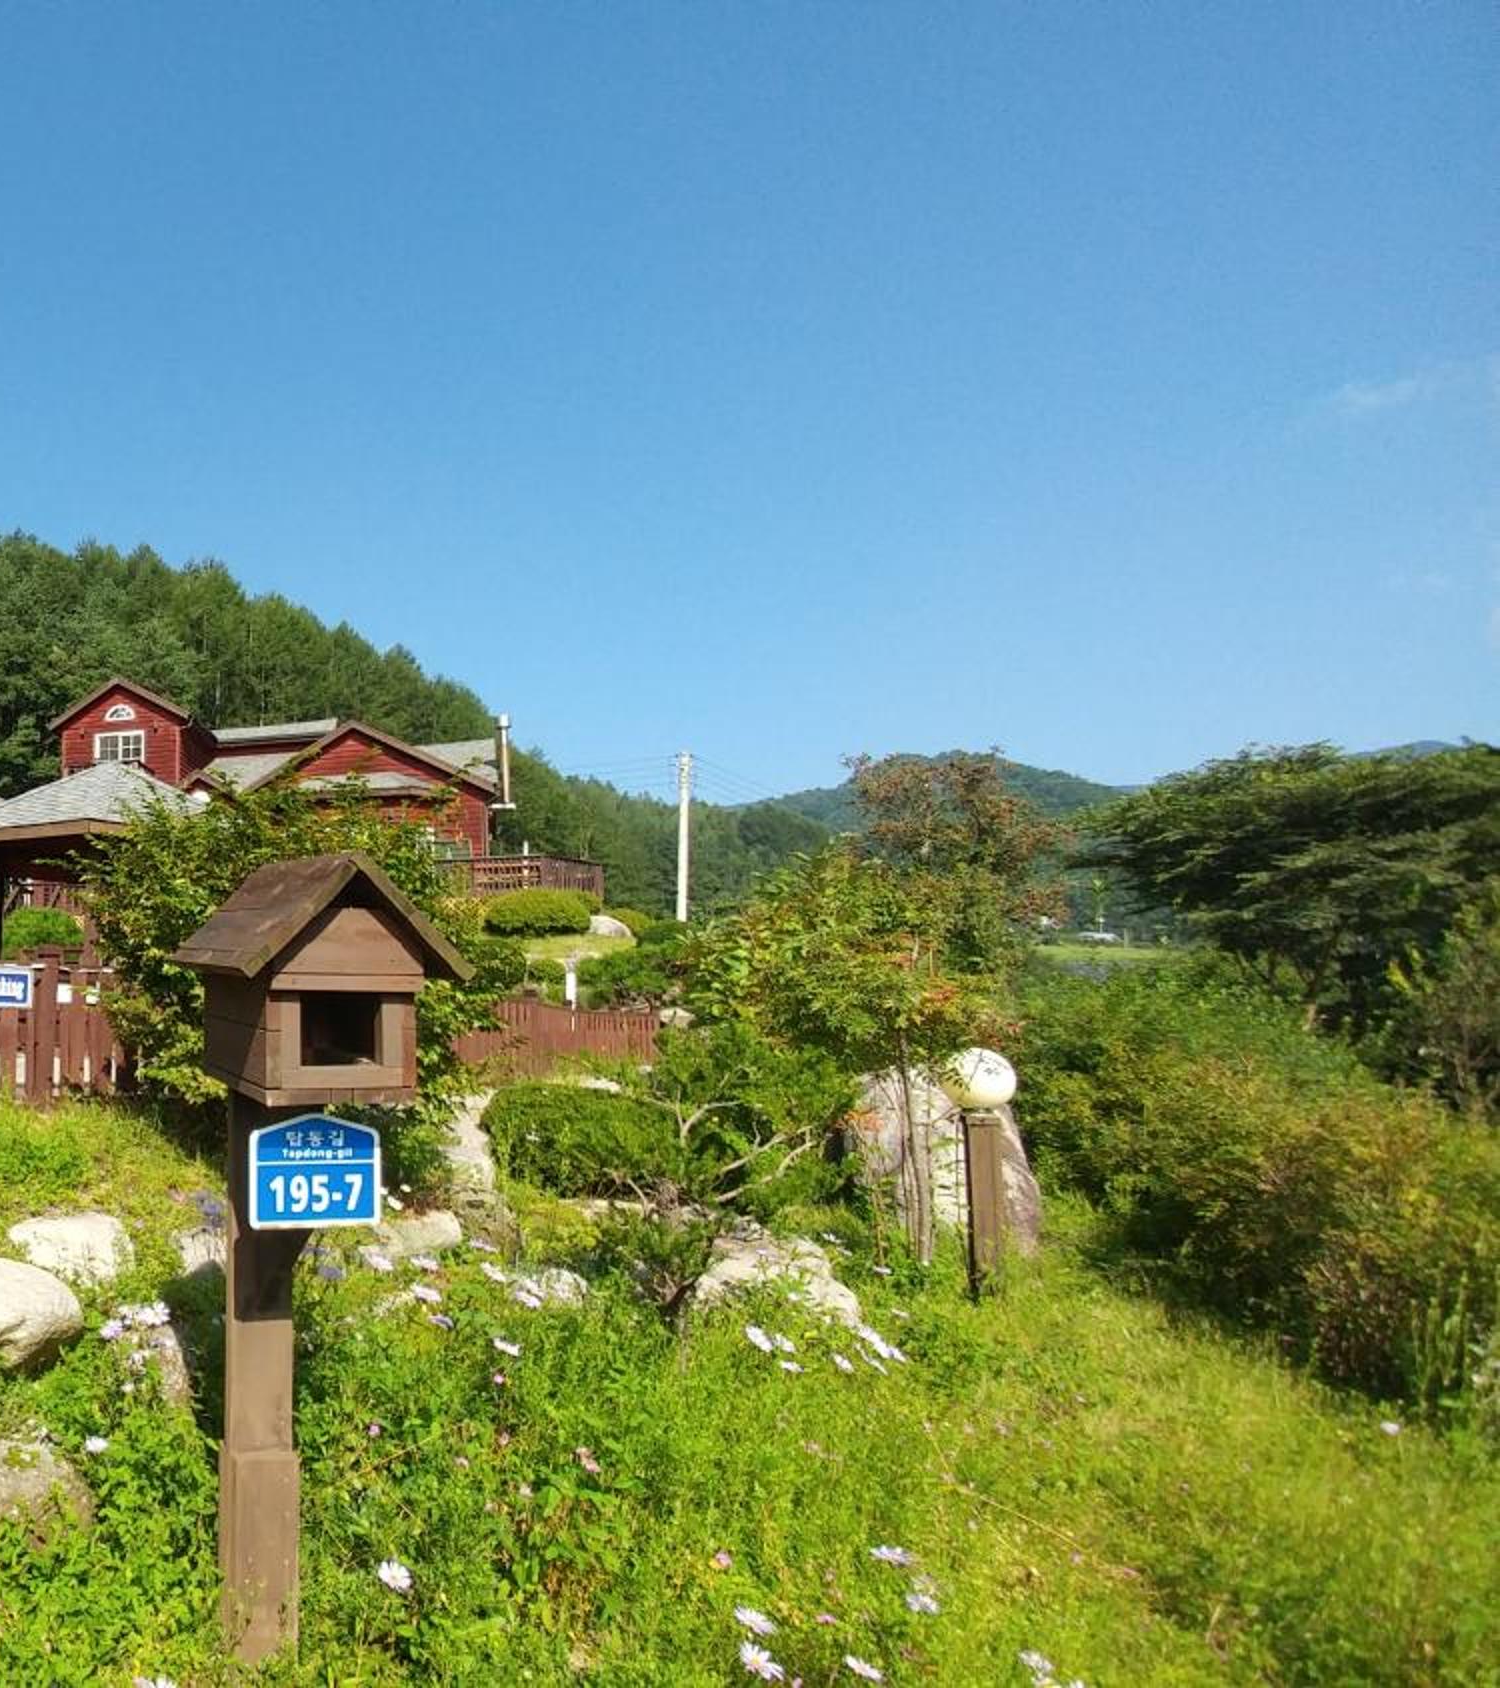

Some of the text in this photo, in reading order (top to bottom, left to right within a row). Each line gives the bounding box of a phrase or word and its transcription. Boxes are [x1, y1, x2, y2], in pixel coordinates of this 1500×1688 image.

[285, 1130, 345, 1147] 탑동길
[282, 1148, 353, 1159] Tapdong-gil
[269, 1173, 364, 1213] 195-7
